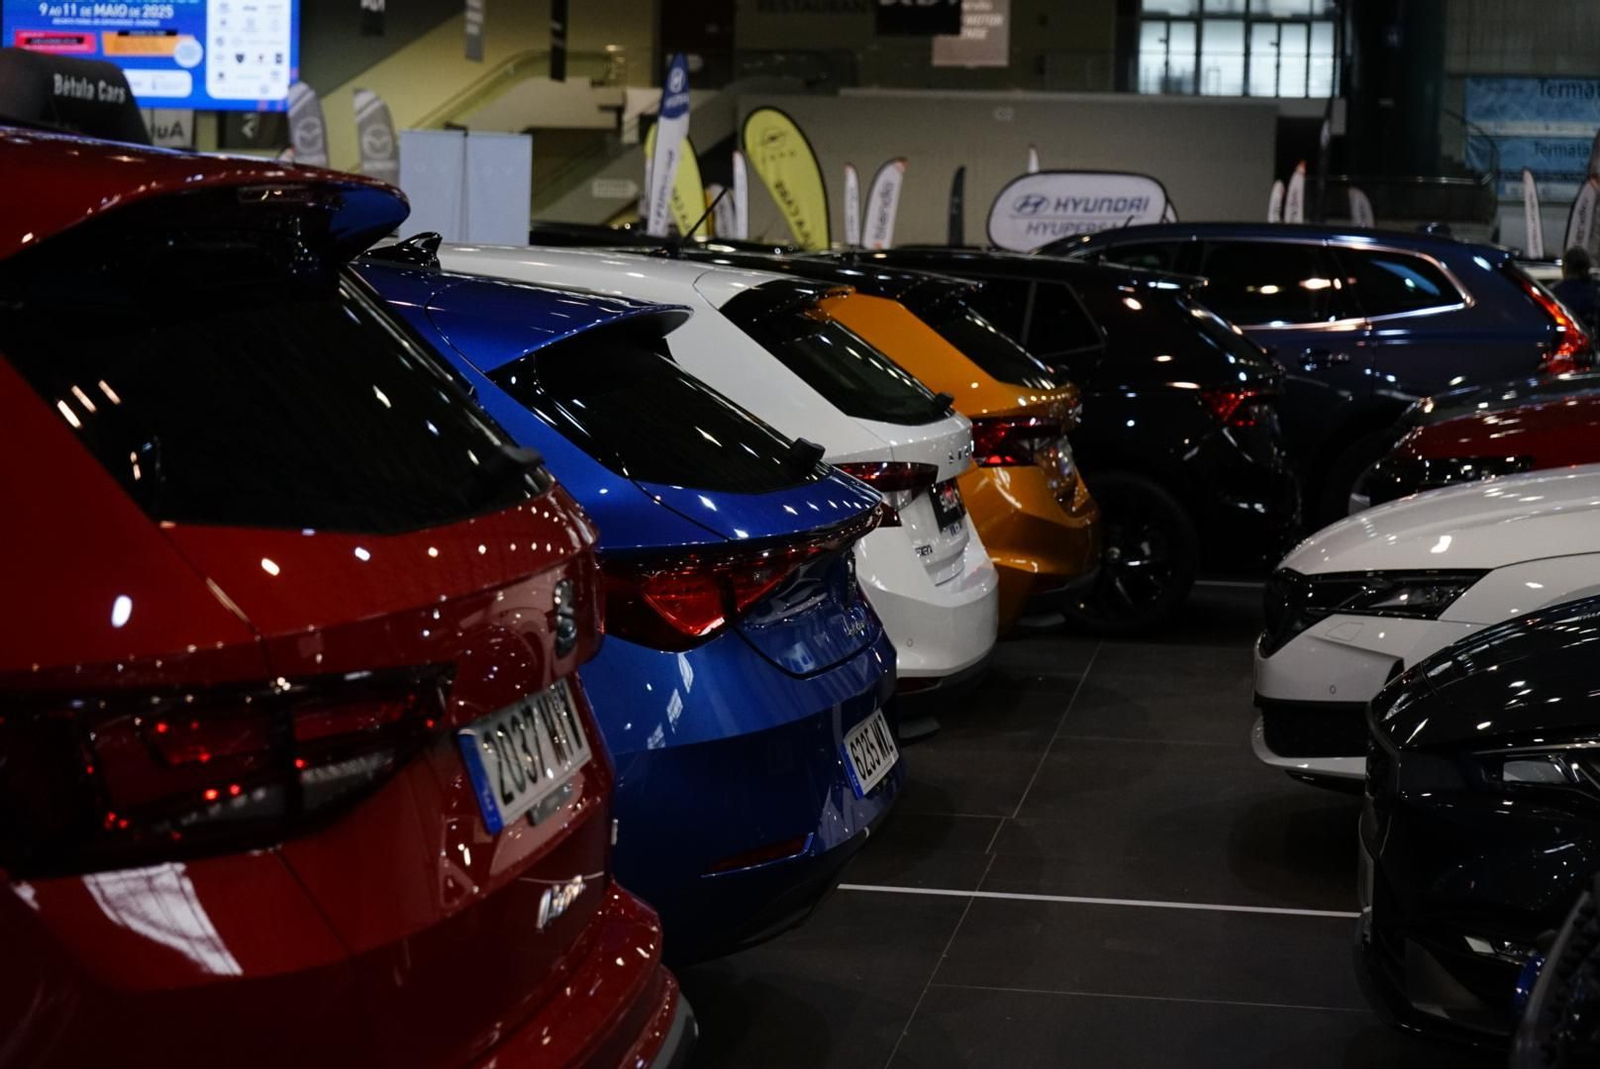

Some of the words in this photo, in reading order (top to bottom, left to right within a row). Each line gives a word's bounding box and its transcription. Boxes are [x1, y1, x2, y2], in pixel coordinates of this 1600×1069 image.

[38, 3, 48, 16] 9
[63, 4, 76, 16] 11
[93, 4, 128, 17] MAIO
[141, 5, 174, 19] 2025
[97, 79, 126, 104] Cars
[1054, 197, 1150, 214] HYUNDAI
[482, 704, 546, 806] 2037
[850, 728, 881, 780] 6235
